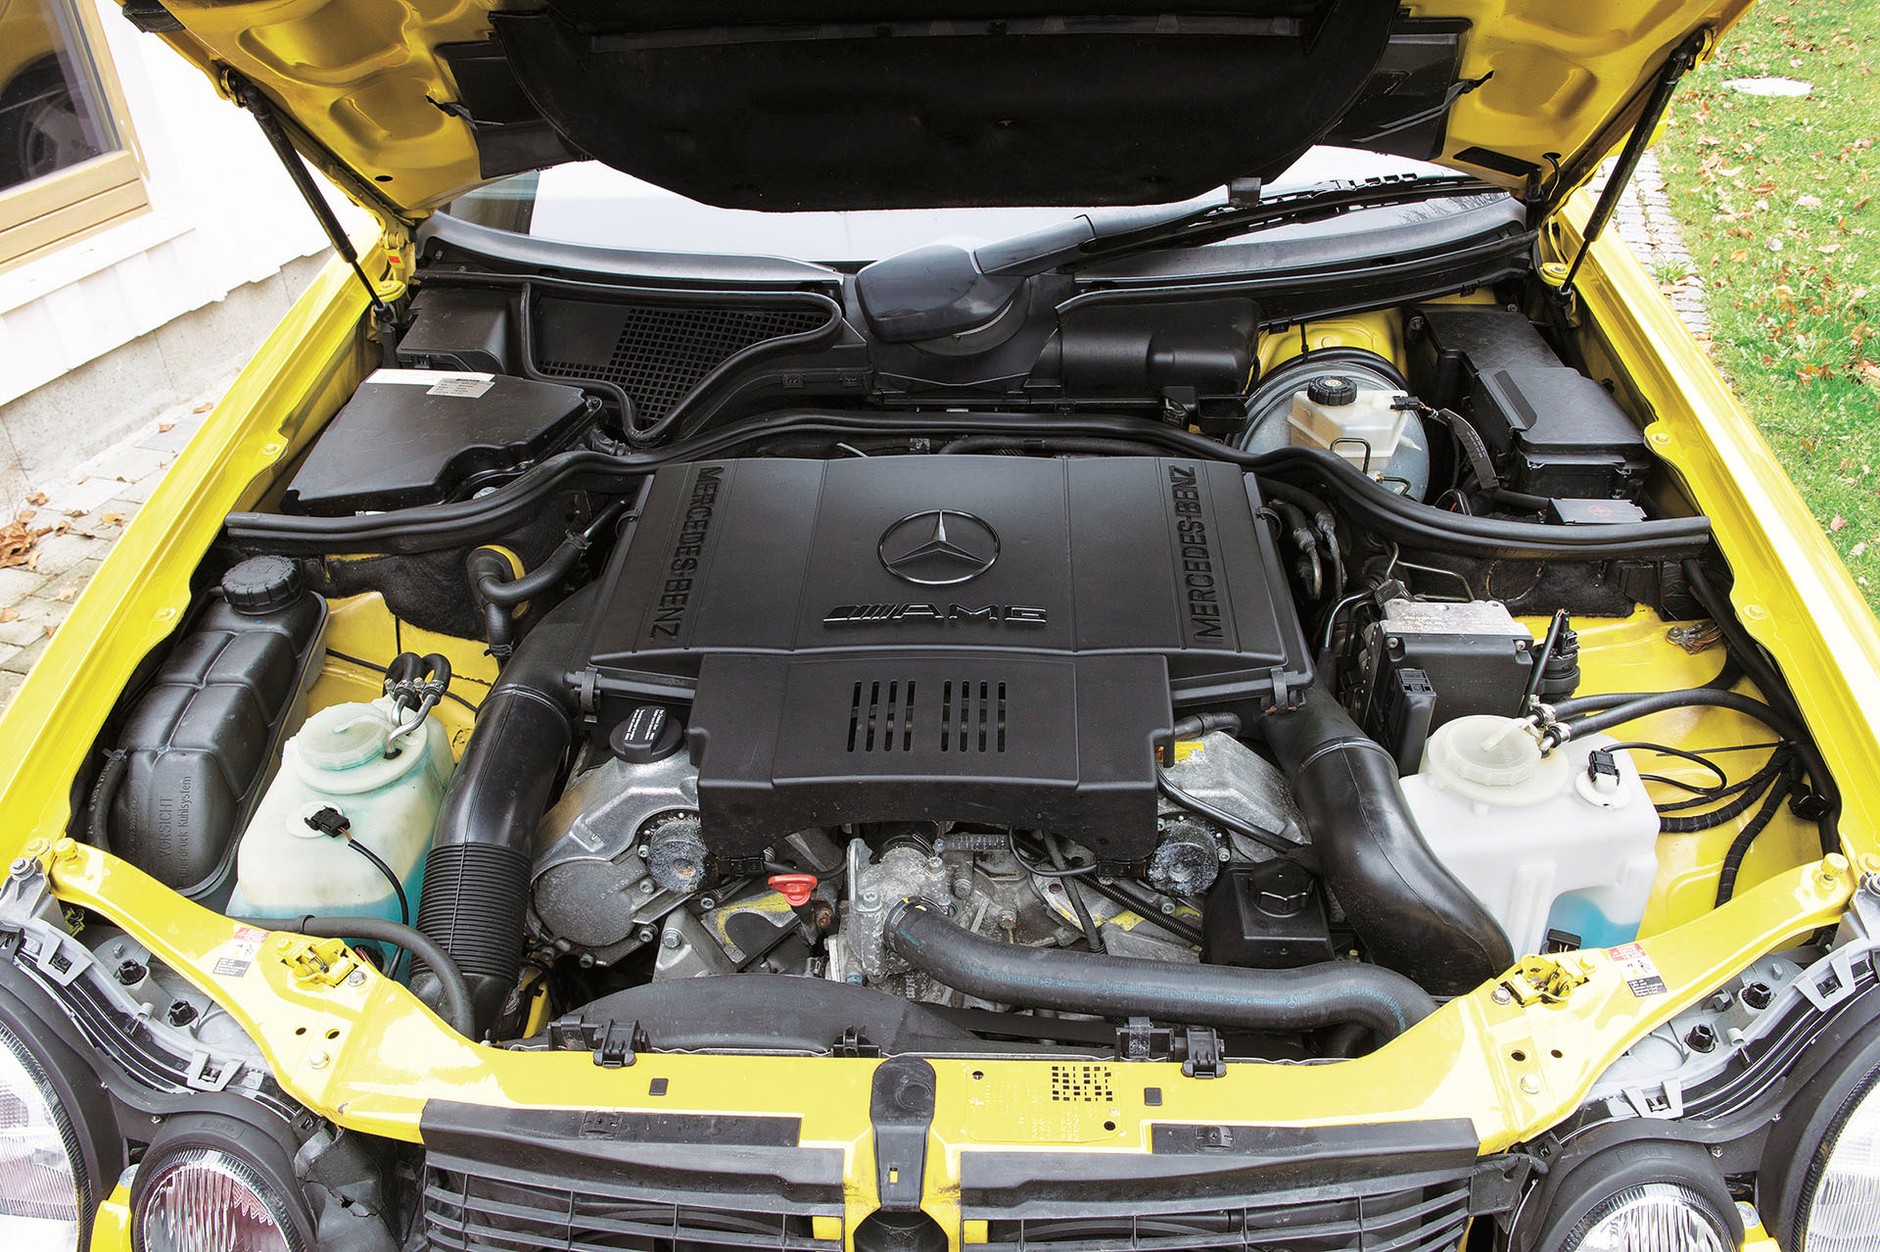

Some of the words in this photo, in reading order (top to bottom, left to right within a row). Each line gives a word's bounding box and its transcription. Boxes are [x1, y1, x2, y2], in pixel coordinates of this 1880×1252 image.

[650, 465, 725, 640] MERCEDES-BENZ
[892, 602, 1047, 623] AMG
[1169, 464, 1224, 641] MERCEDES-BENZ
